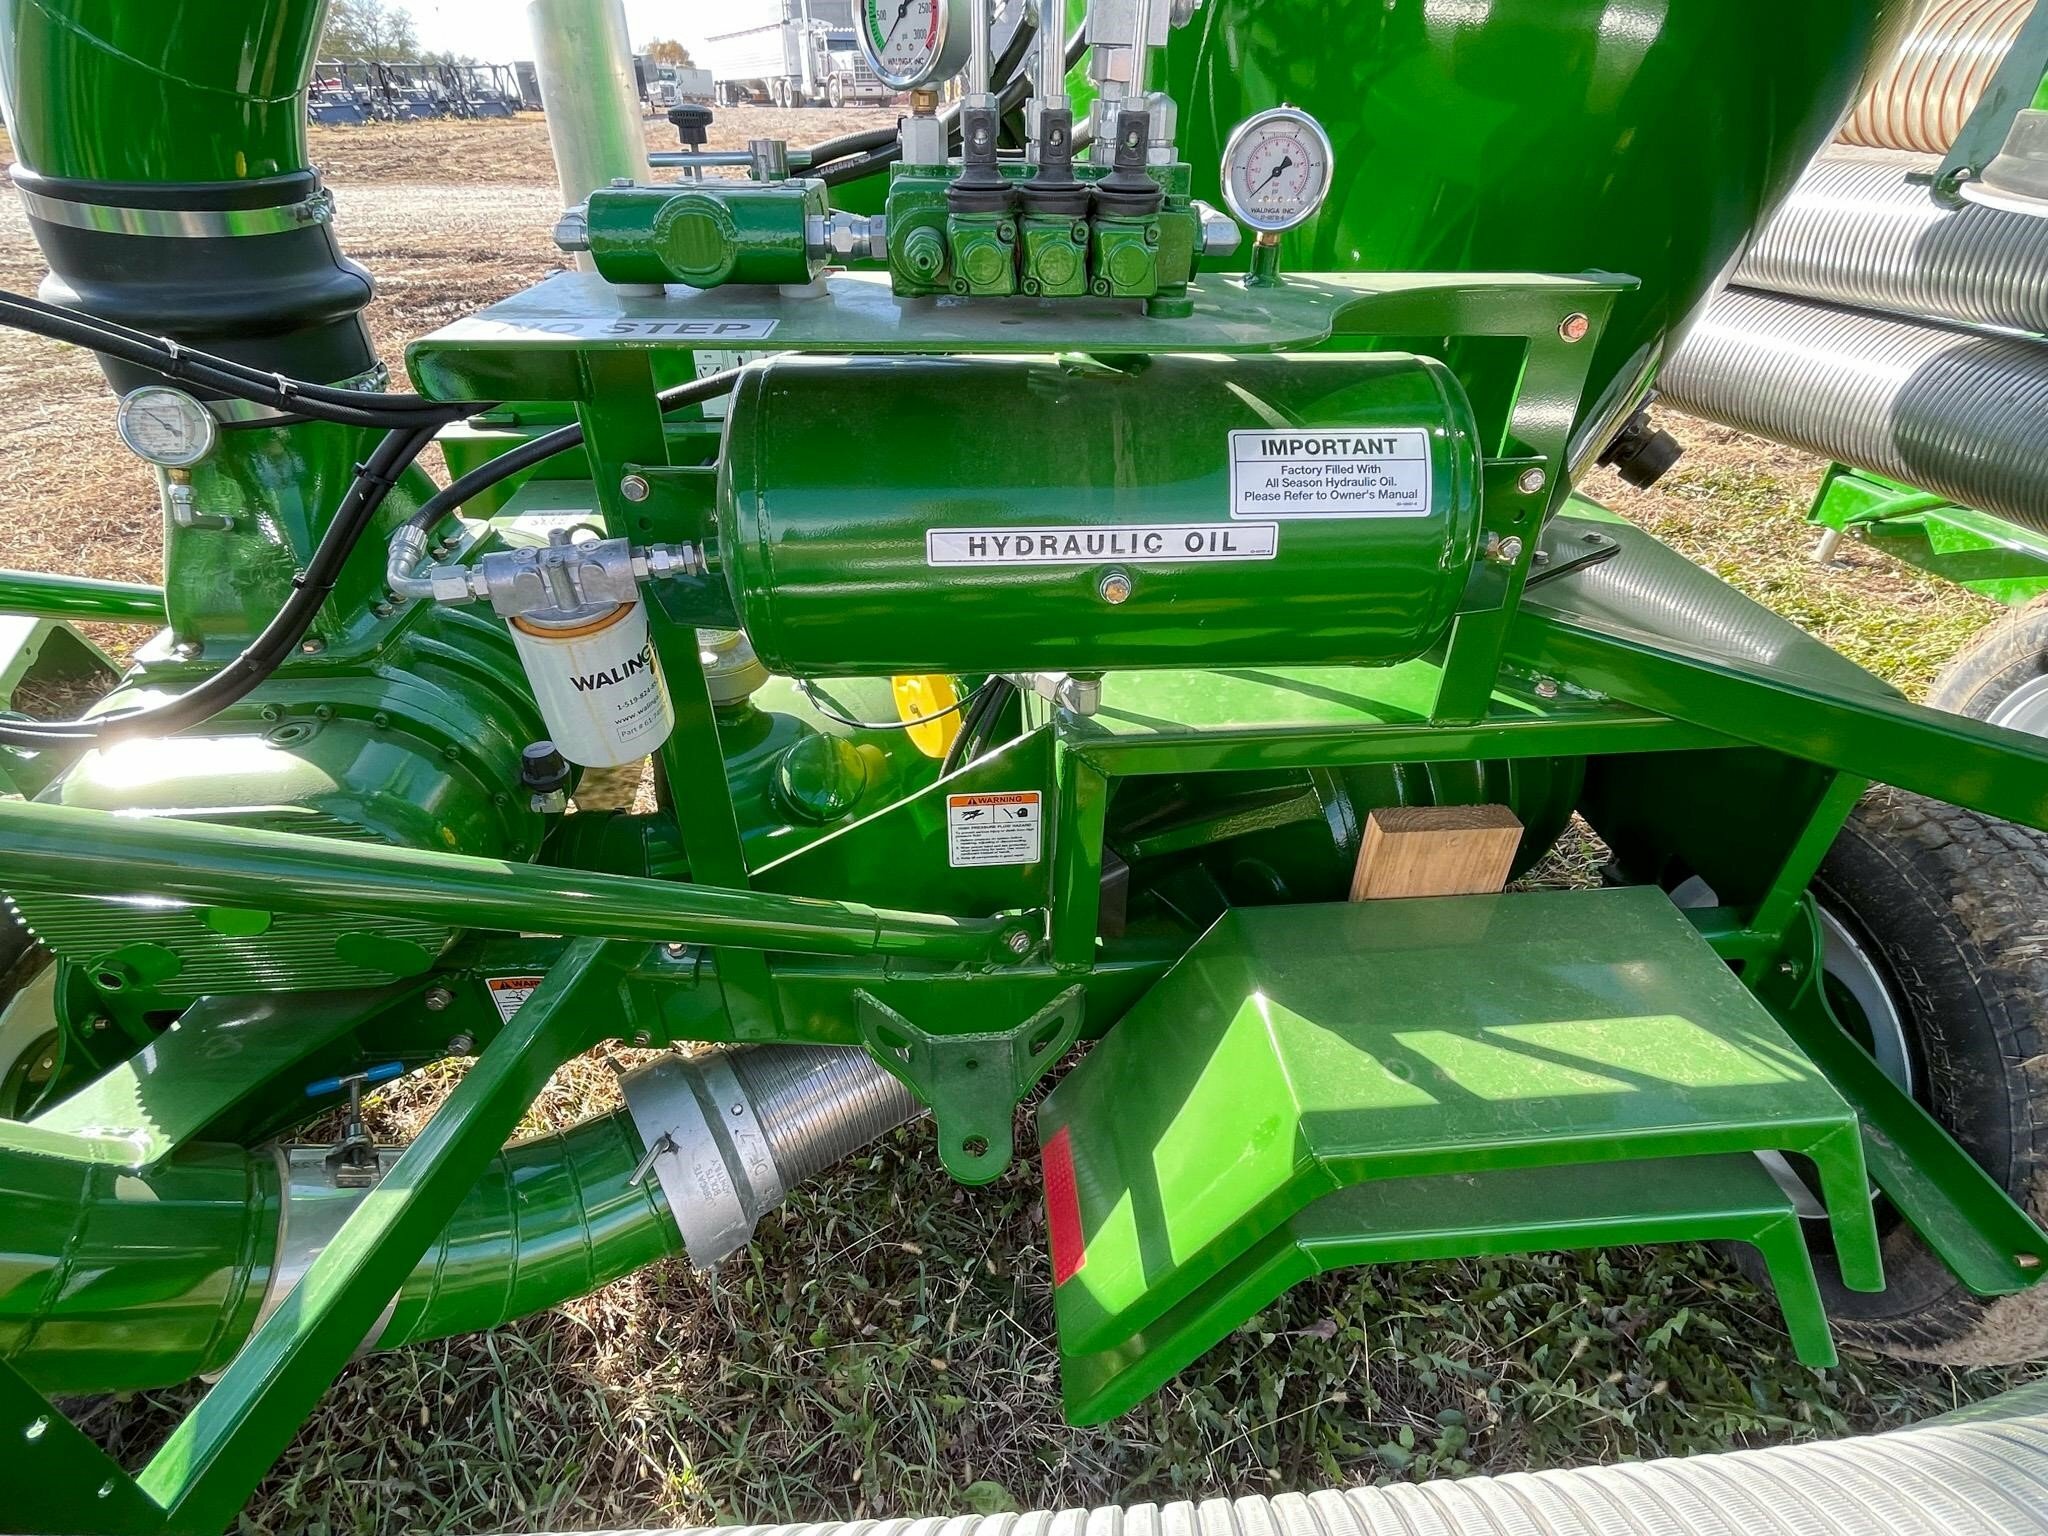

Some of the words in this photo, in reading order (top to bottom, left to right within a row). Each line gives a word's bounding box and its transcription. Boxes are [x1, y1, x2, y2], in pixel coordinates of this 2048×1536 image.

[877, 10, 887, 21] 500
[913, 28, 927, 40] 3000
[497, 322, 584, 334] NO
[602, 322, 752, 335] STEP
[1261, 438, 1398, 456] IMPORTANT
[1281, 465, 1323, 476] Factory
[1325, 464, 1354, 475] Filled
[1357, 464, 1381, 474] With
[1265, 478, 1279, 488] All
[1282, 478, 1323, 487] Season
[1325, 477, 1377, 488] Hydraulic
[1379, 476, 1398, 487] Oil.
[1244, 491, 1281, 501] Please
[1284, 490, 1314, 500] Refer
[1316, 491, 1327, 500] to
[1330, 489, 1375, 500] Owner's
[1378, 489, 1418, 499] Manual
[968, 532, 1164, 557] HYDRAULIC
[1184, 531, 1238, 553] OIL
[570, 642, 653, 692] WALING
[621, 726, 638, 738] Part
[977, 795, 1023, 804] WARNING
[705, 1168, 722, 1197] BOLTS
